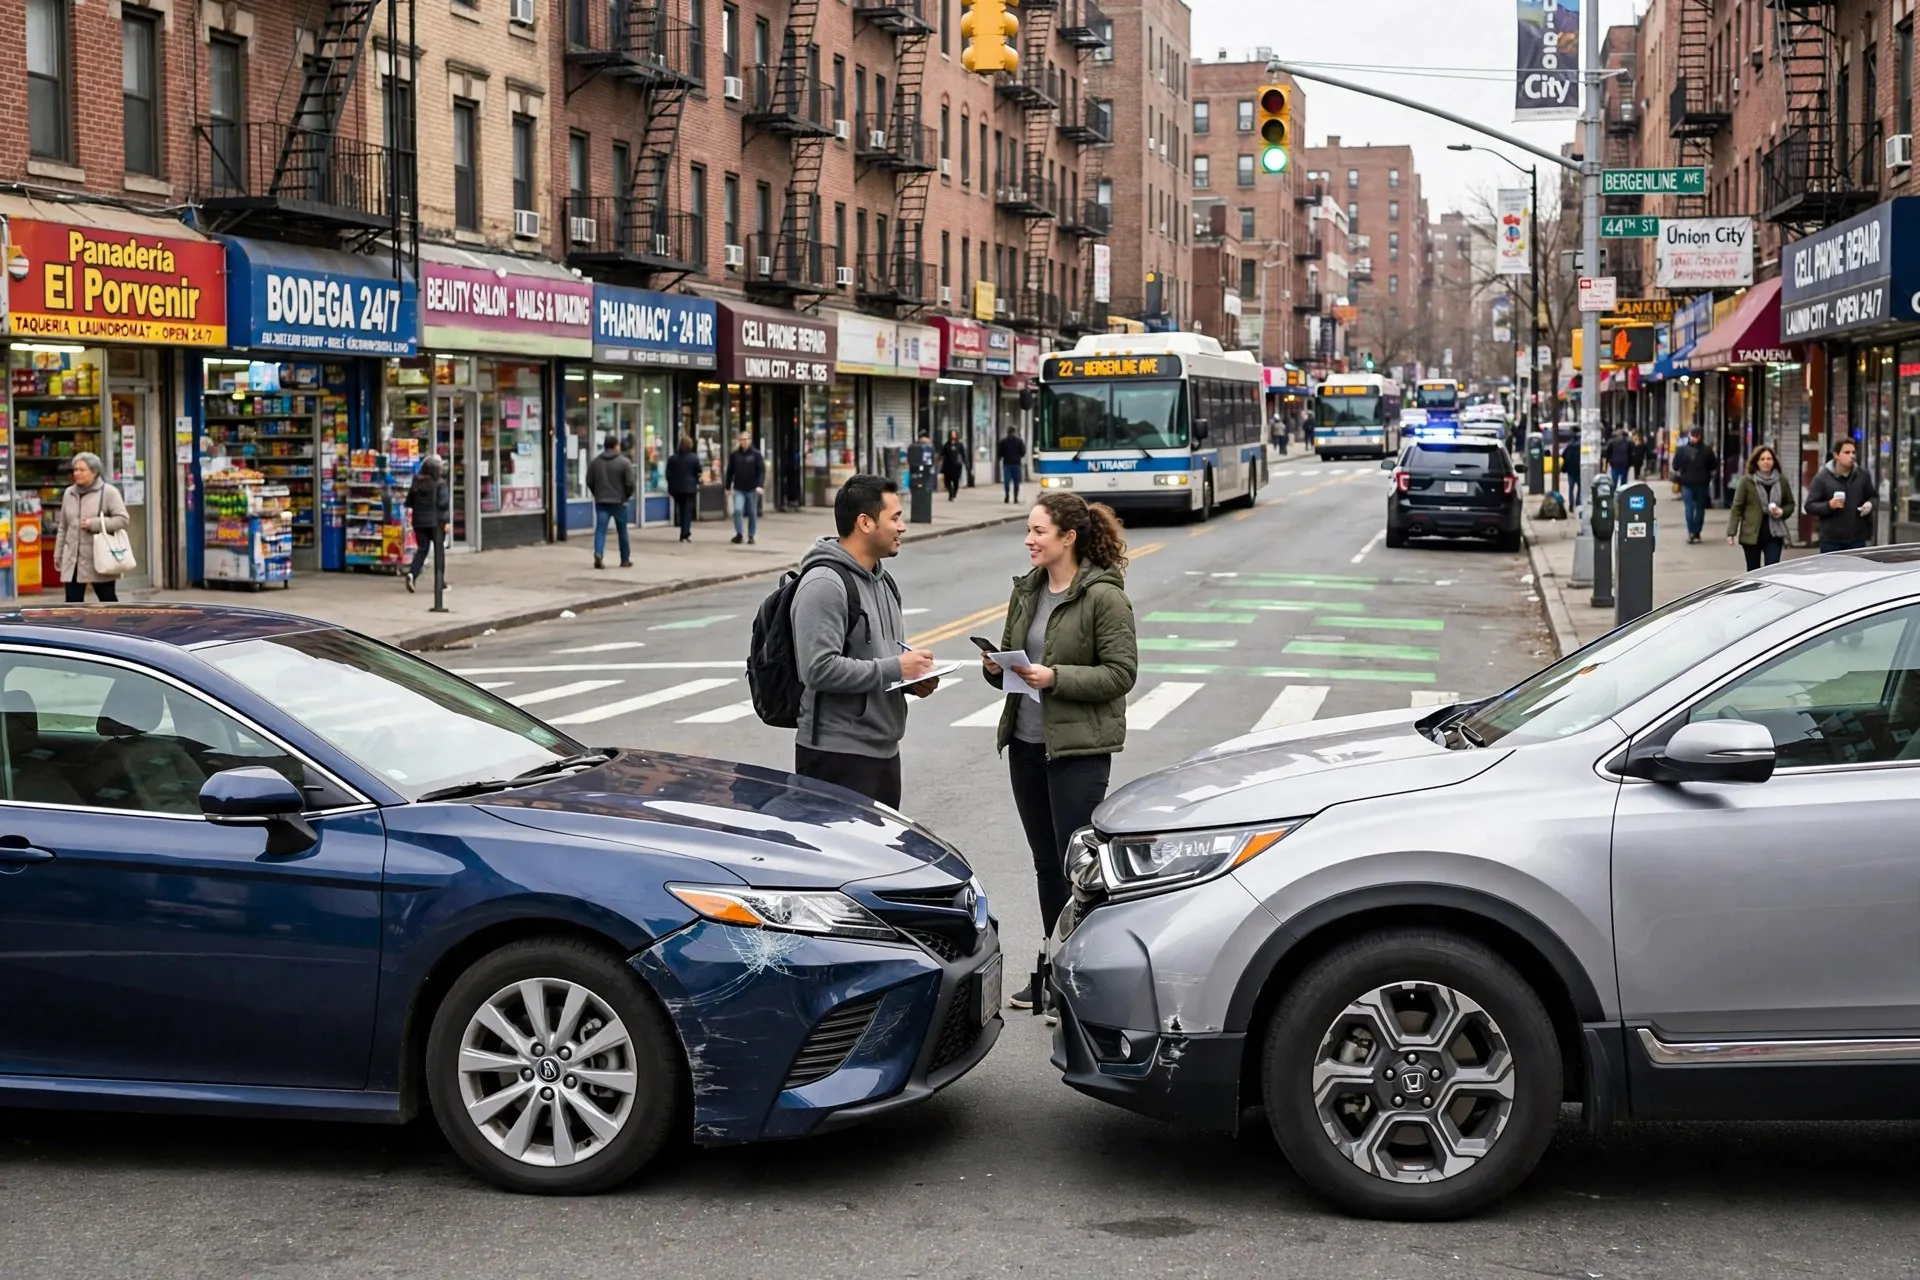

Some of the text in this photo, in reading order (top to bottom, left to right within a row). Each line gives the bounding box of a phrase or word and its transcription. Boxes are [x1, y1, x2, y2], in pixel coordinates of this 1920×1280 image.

[1525, 74, 1570, 103] City
[1605, 172, 1700, 190] BERGENLINE AVE
[1605, 219, 1655, 235] 44TH ST
[1667, 224, 1745, 246] Union City
[69, 231, 175, 273] Panadería
[1795, 220, 1881, 289] CELL PHONE REPAIR
[44, 263, 200, 319] El Porvenir
[267, 274, 401, 334] BODEGA 24/7
[427, 277, 471, 313] BEAUTY
[472, 283, 508, 317] SALON
[515, 289, 544, 321] NAILS
[546, 292, 554, 322] &
[1836, 294, 1859, 325] OPEN
[1860, 288, 1883, 319] 24/7
[15, 316, 70, 334] TAQUERIA
[78, 321, 151, 338] LAUNDROMAT
[162, 329, 189, 341] OPEN
[600, 299, 713, 345] PHARMACY 24 HR
[742, 320, 765, 347] CELL
[767, 323, 797, 350] PHONE
[745, 358, 770, 378] UNION
[771, 360, 790, 379] CITY
[1059, 361, 1073, 376] 22
[1101, 460, 1138, 470] TRANSIT
